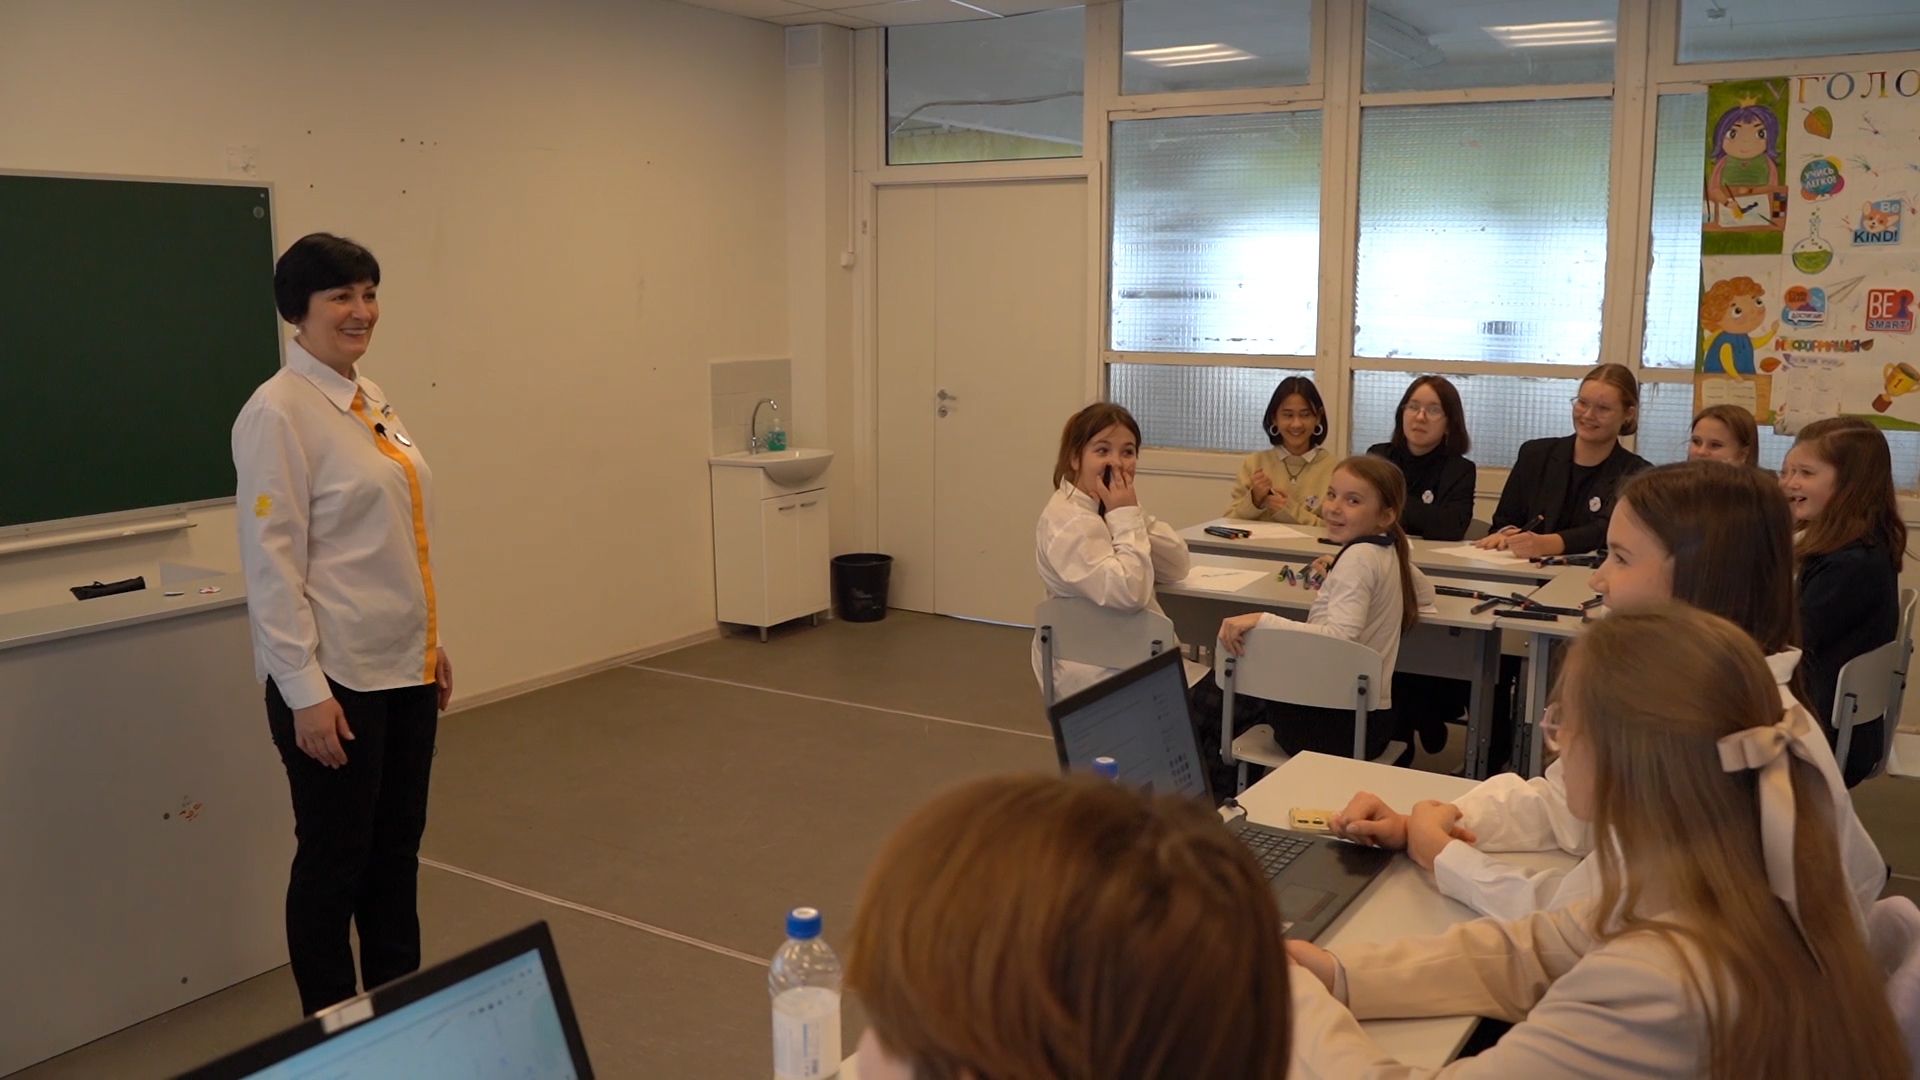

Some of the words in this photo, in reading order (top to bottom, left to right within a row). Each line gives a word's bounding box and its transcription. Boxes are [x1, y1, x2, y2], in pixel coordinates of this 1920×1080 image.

[1804, 167, 1834, 179] УЧИСЬ
[1854, 230, 1898, 243] KIND!
[1869, 291, 1894, 318] BE
